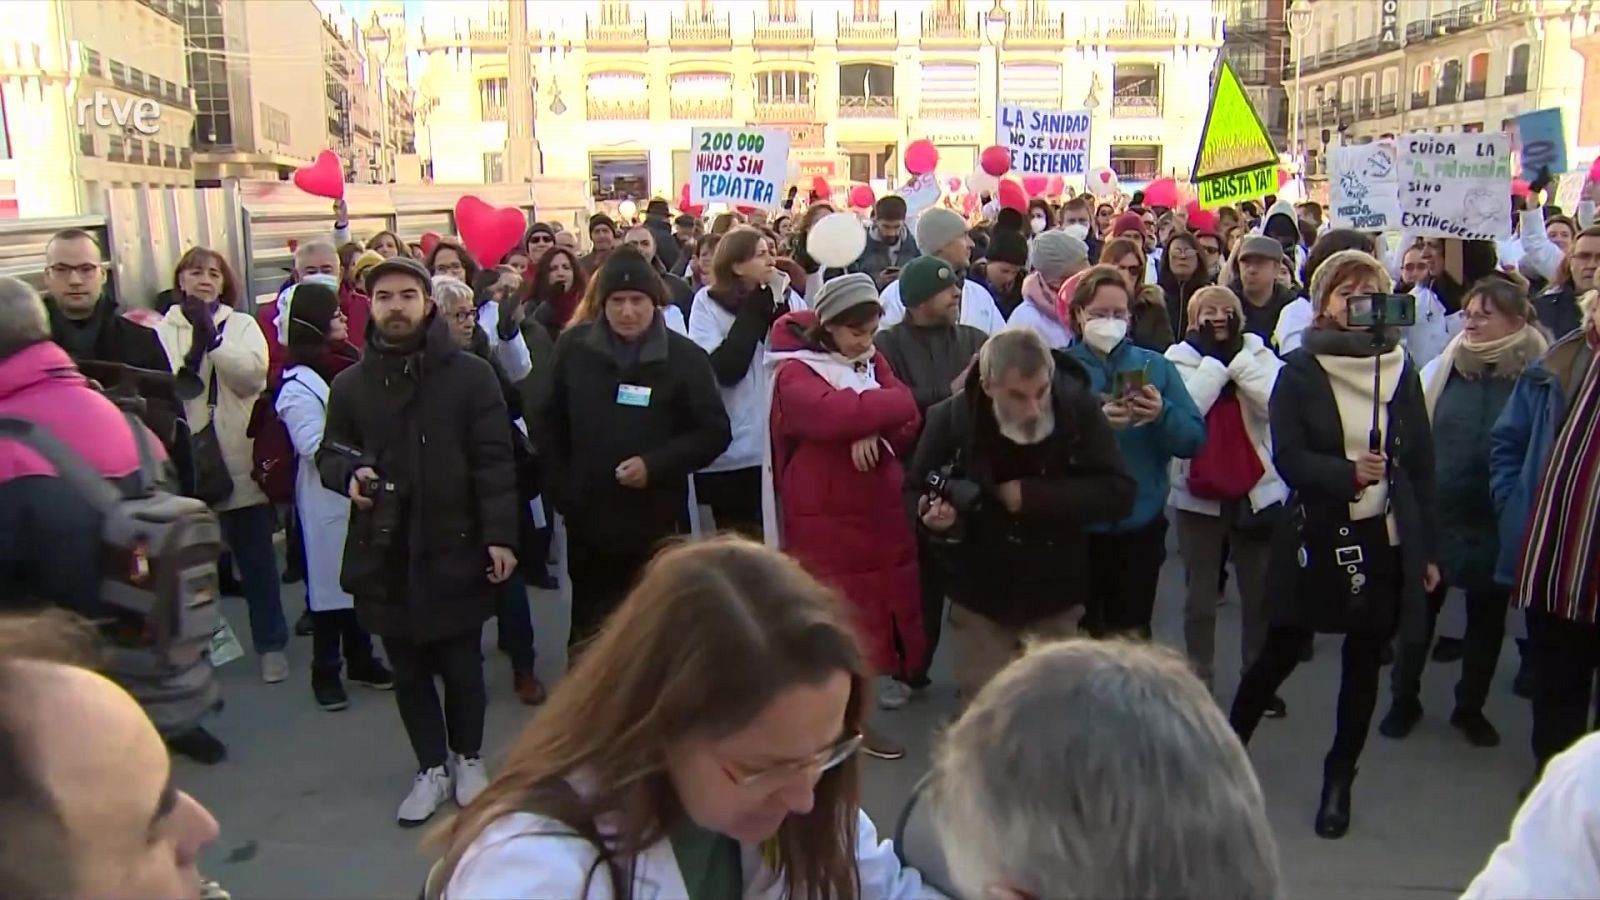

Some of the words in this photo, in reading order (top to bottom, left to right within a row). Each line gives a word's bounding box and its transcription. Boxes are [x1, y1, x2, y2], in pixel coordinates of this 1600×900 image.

[1002, 107, 1024, 129] LA
[1030, 111, 1089, 133] SANIDAD
[1009, 132, 1025, 147] NO
[1029, 137, 1044, 149] SE
[1049, 138, 1086, 150] VENDE
[1409, 137, 1455, 155] CUIDA
[1476, 142, 1495, 157] LA
[737, 155, 764, 175] SIN
[1023, 152, 1084, 173] DEFIENDE
[701, 173, 774, 203] PEDIATRA
[1408, 181, 1441, 192] SINO
